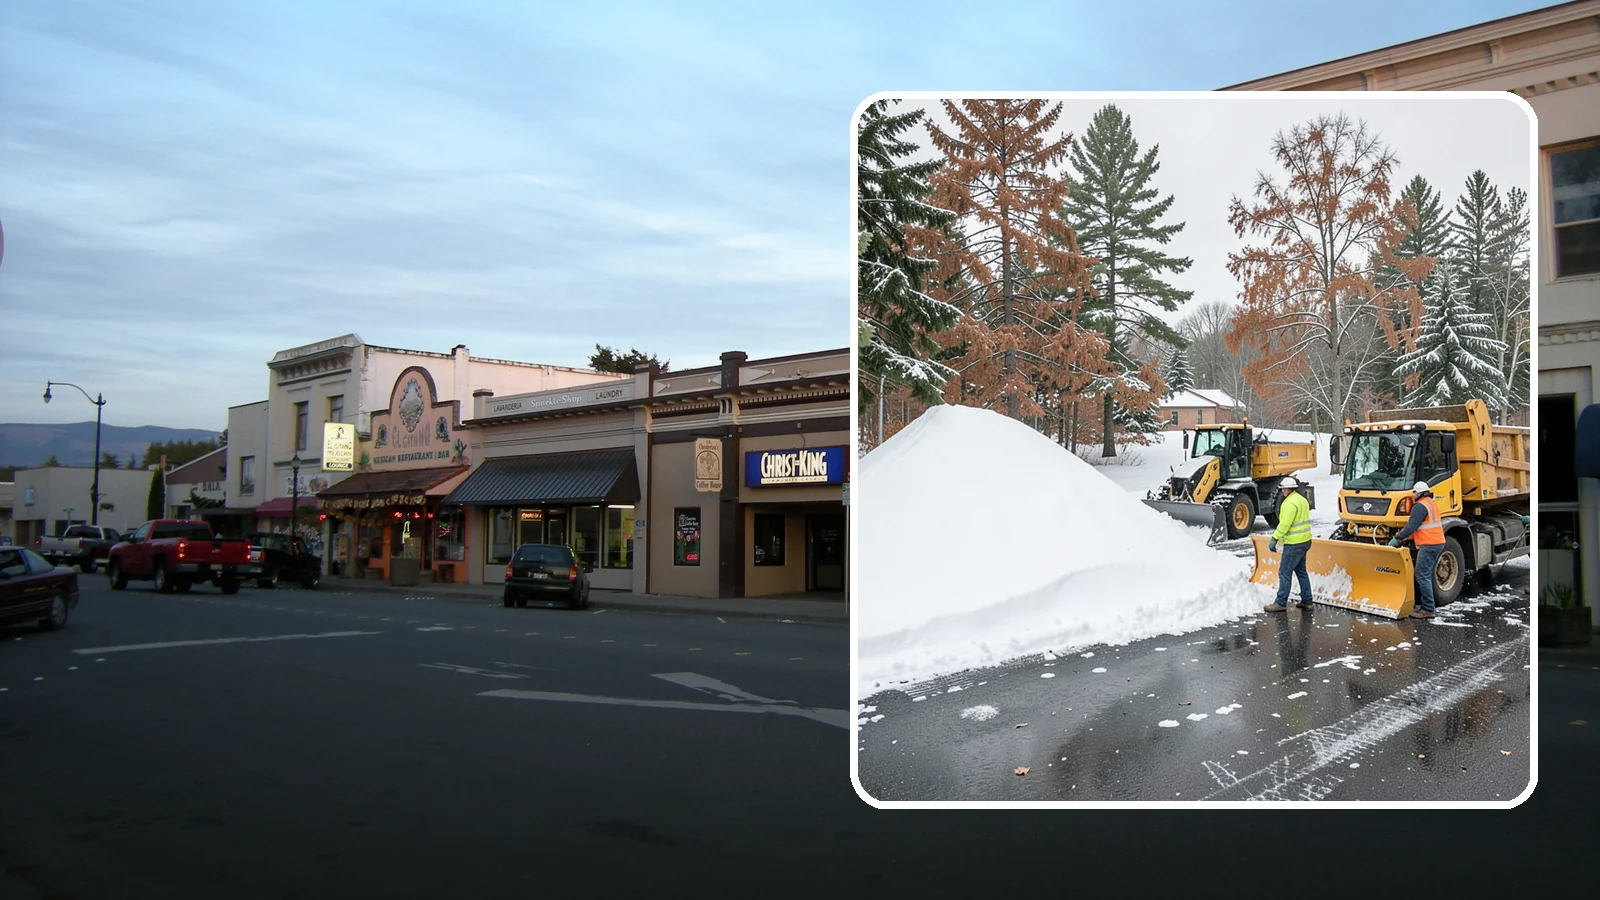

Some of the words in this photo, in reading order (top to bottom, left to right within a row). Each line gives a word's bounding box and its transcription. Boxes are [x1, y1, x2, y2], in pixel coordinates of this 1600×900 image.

[530, 396, 561, 408] Sparkle
[562, 394, 582, 405] Shop
[595, 389, 623, 400] LAUNDRY
[493, 401, 522, 413] LAVANDERIA
[373, 454, 396, 464] MEXICAN
[397, 451, 433, 462] RESTAURANT
[437, 450, 450, 459] BAR
[760, 451, 797, 478] CHRIST
[799, 450, 827, 476] KING
